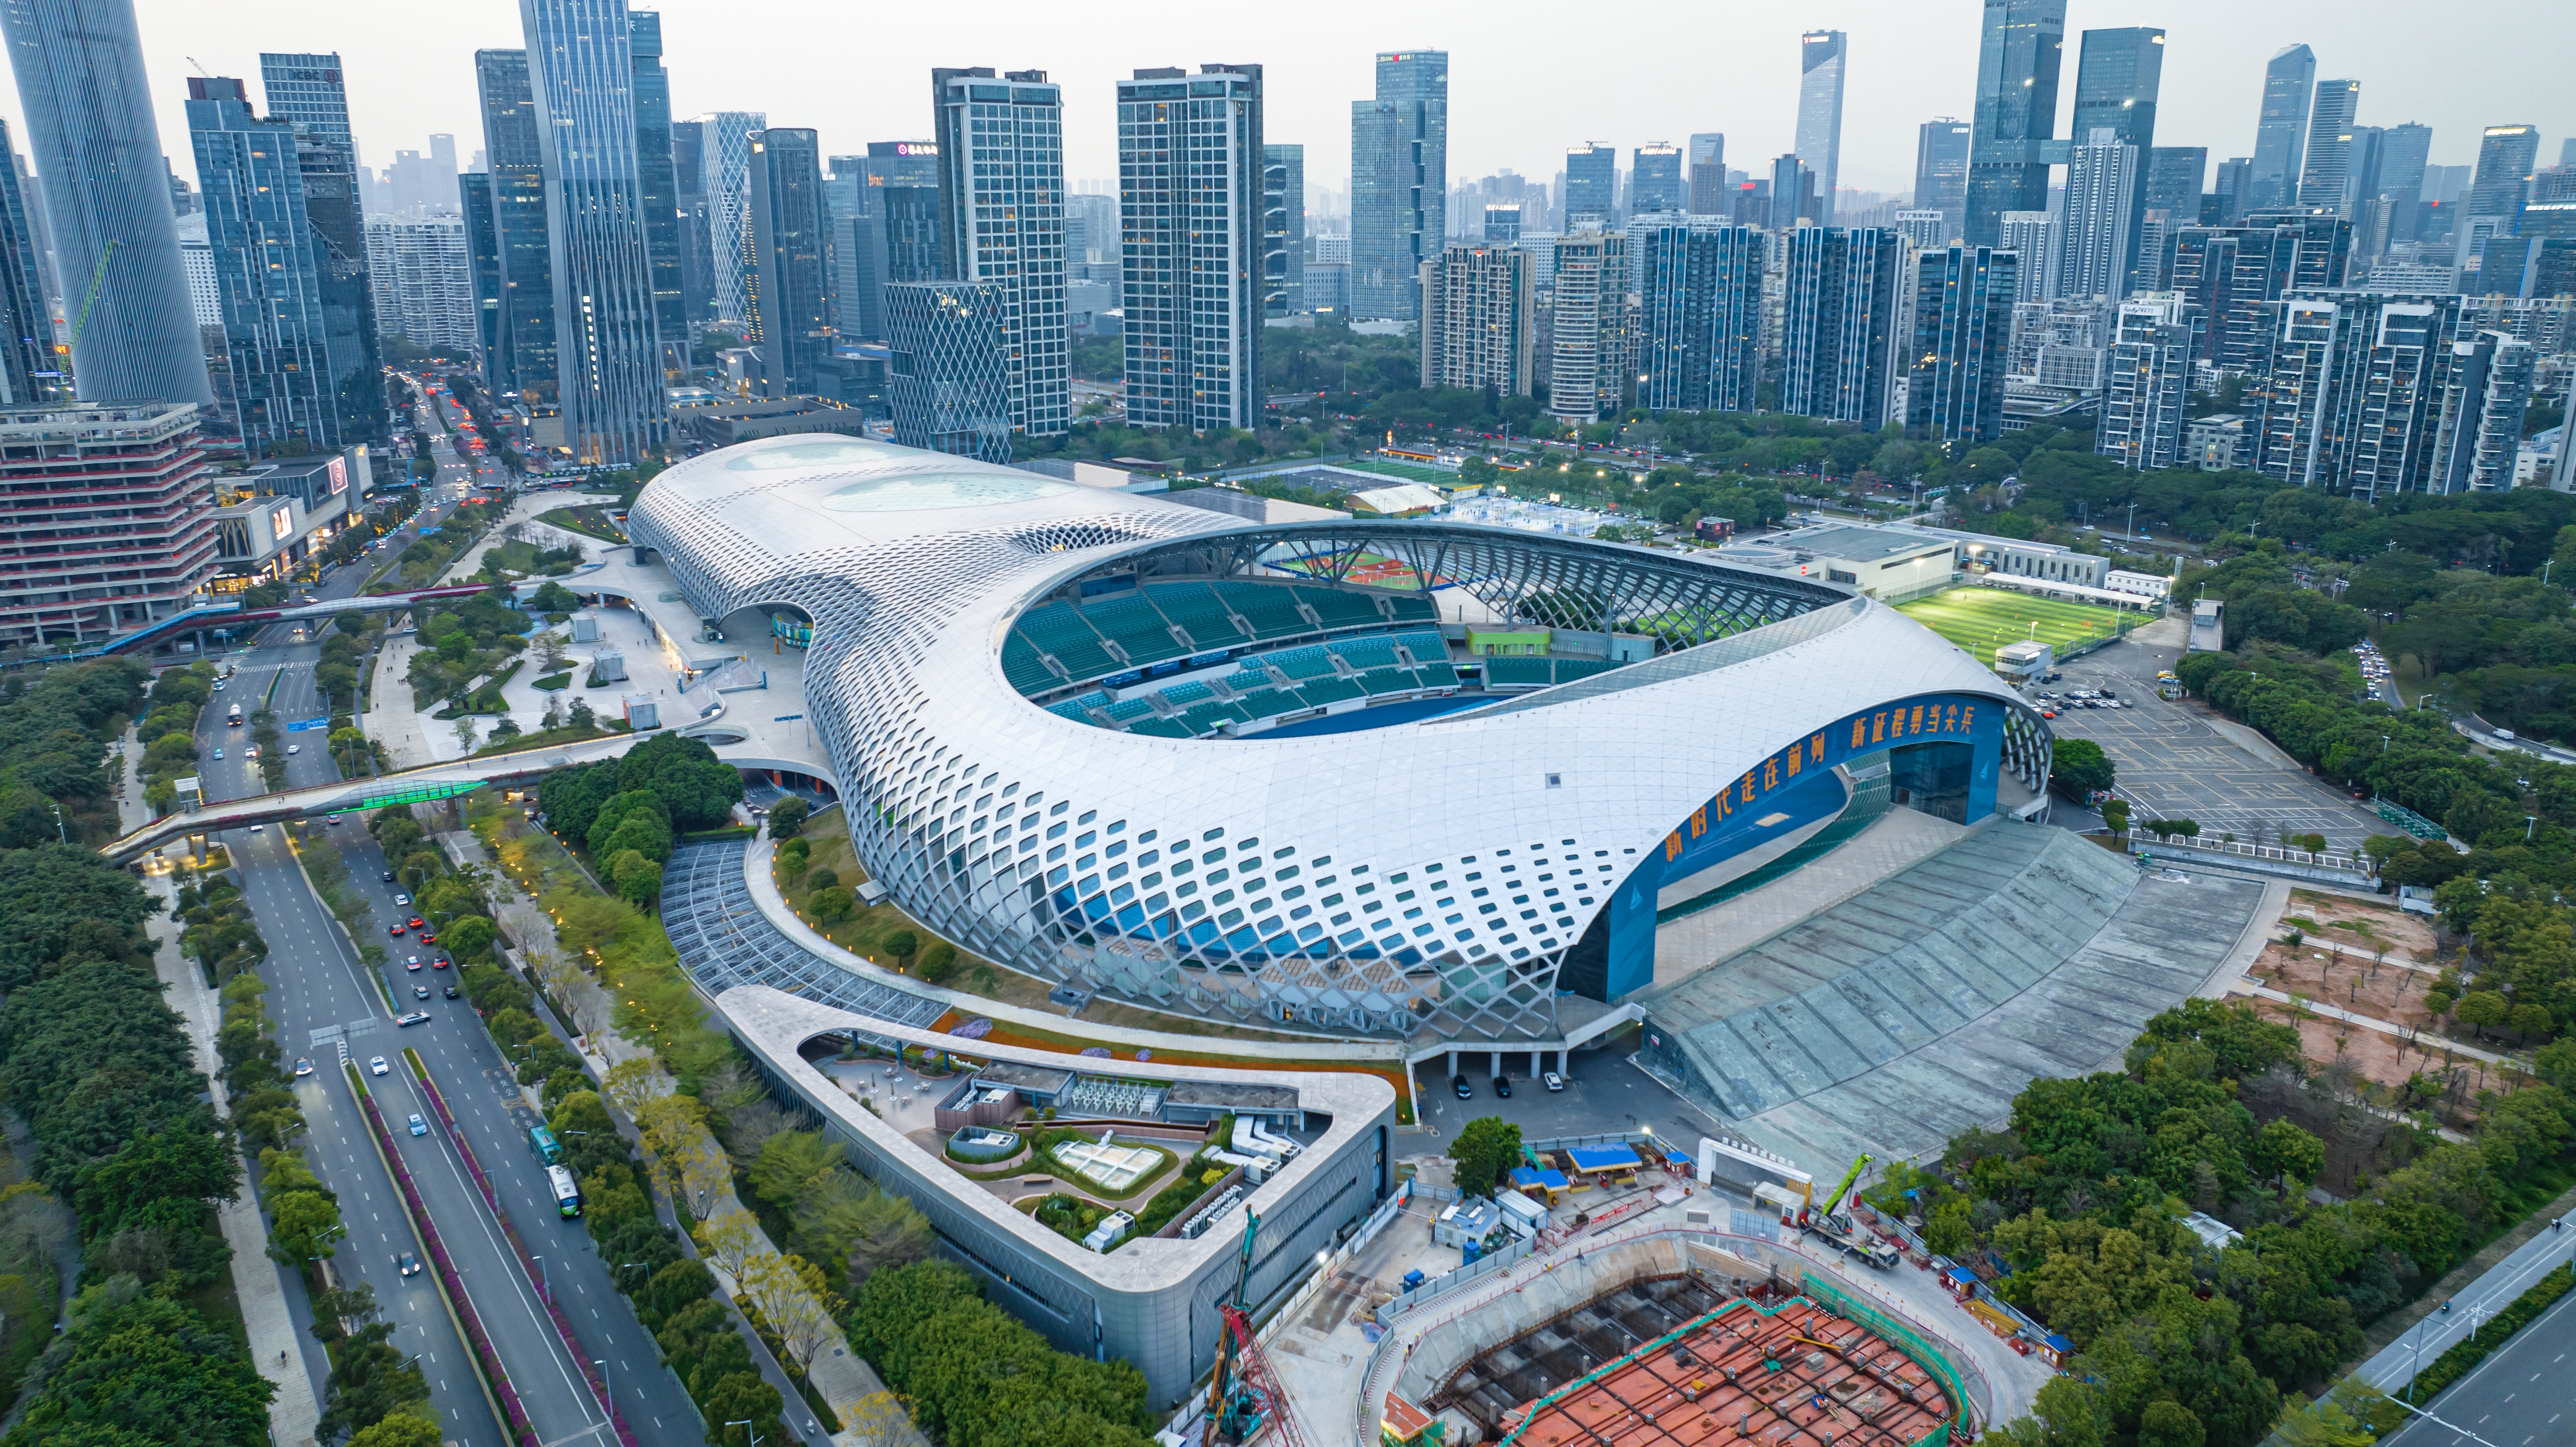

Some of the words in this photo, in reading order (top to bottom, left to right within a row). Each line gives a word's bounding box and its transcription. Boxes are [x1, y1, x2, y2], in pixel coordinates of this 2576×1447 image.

[293, 71, 320, 80] ICBC
[1851, 704, 1975, 748] 新征程勇当尖兵
